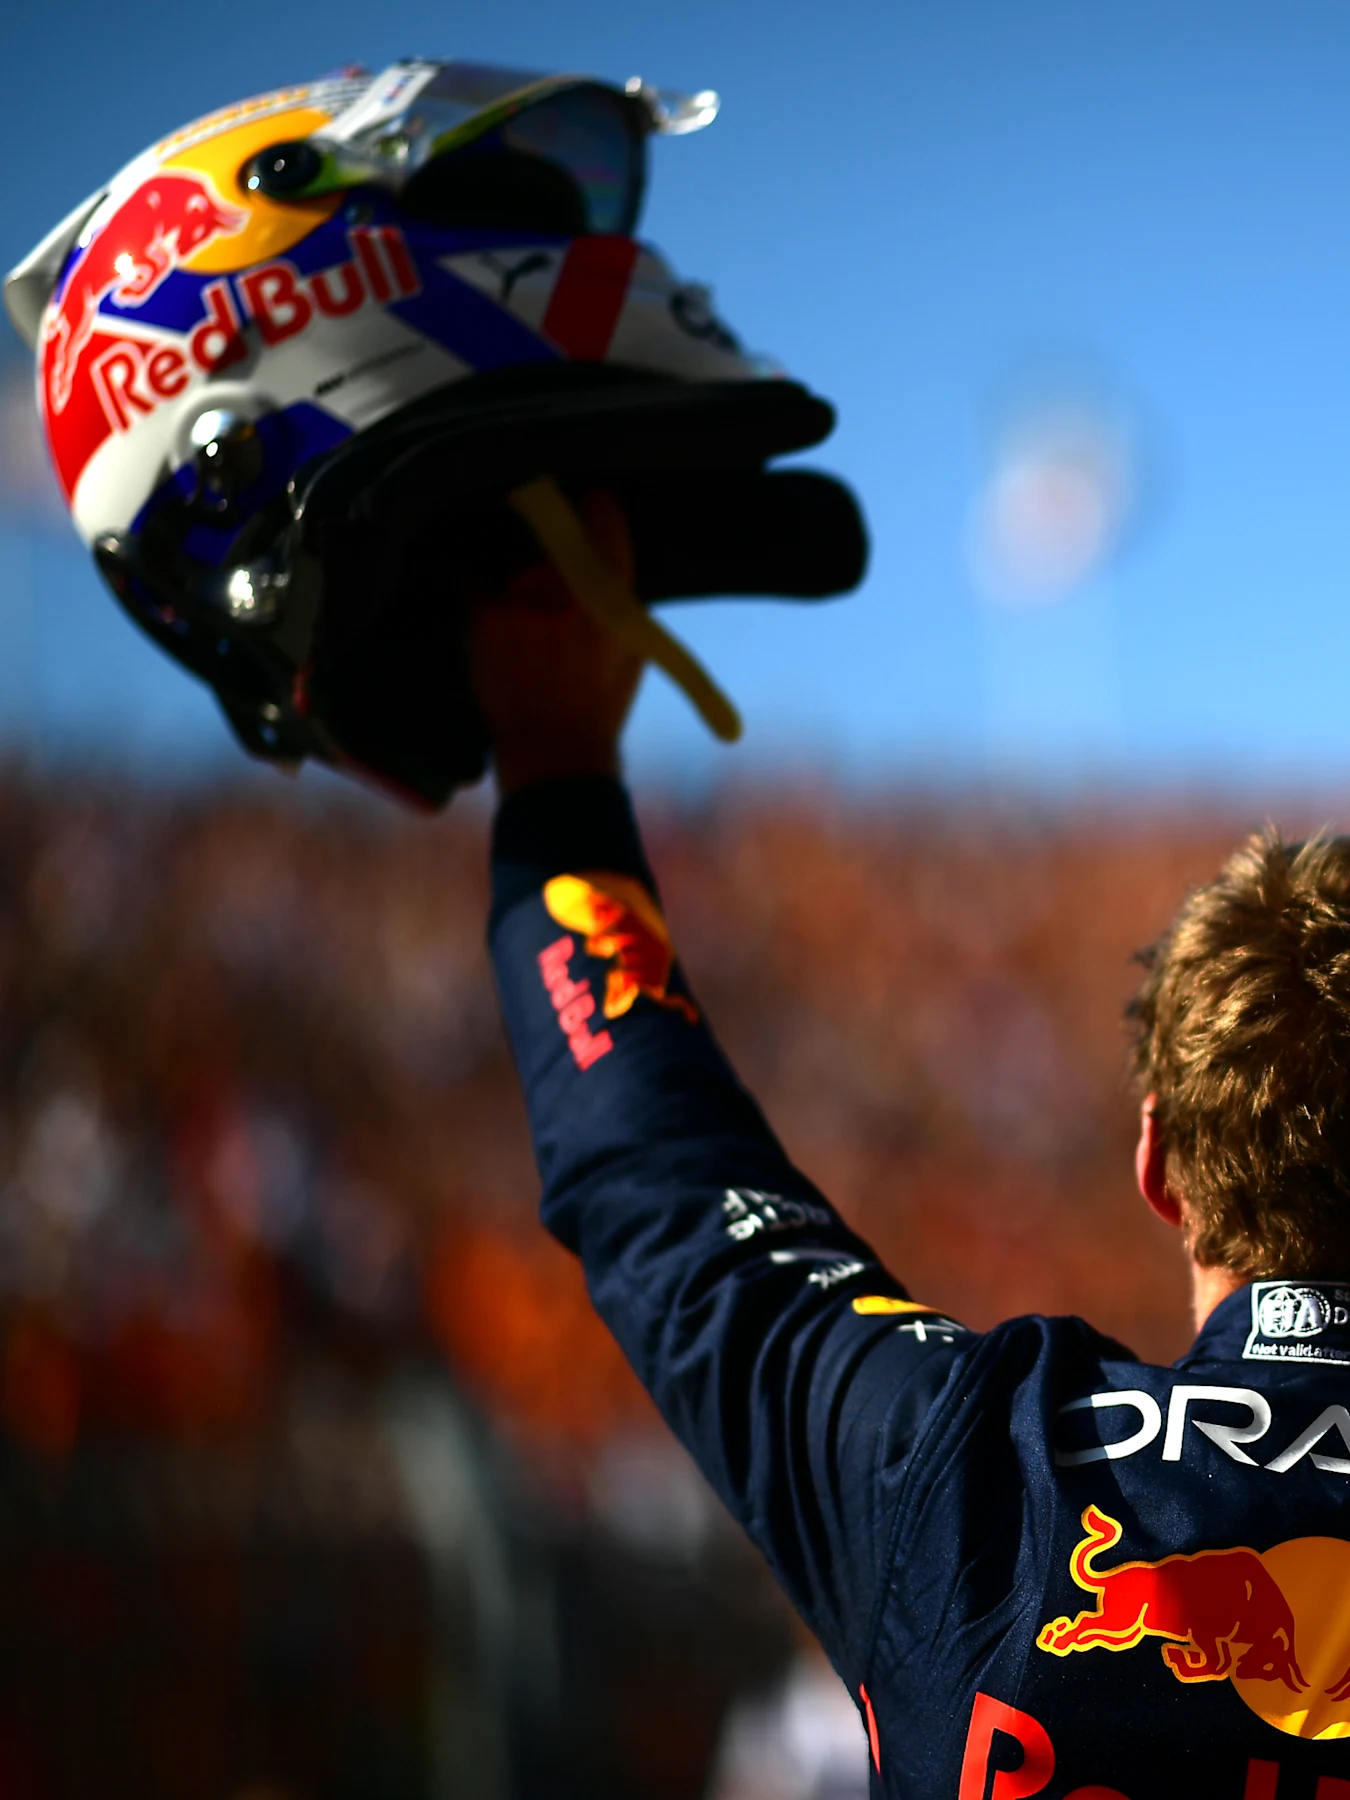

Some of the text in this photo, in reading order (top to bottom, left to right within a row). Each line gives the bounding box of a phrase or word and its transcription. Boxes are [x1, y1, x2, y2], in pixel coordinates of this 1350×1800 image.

[92, 282, 248, 433] Red
[241, 227, 421, 346] Bull
[1264, 1296, 1323, 1333] FIA
[1252, 1342, 1278, 1355] Not
[1280, 1343, 1313, 1357] valid
